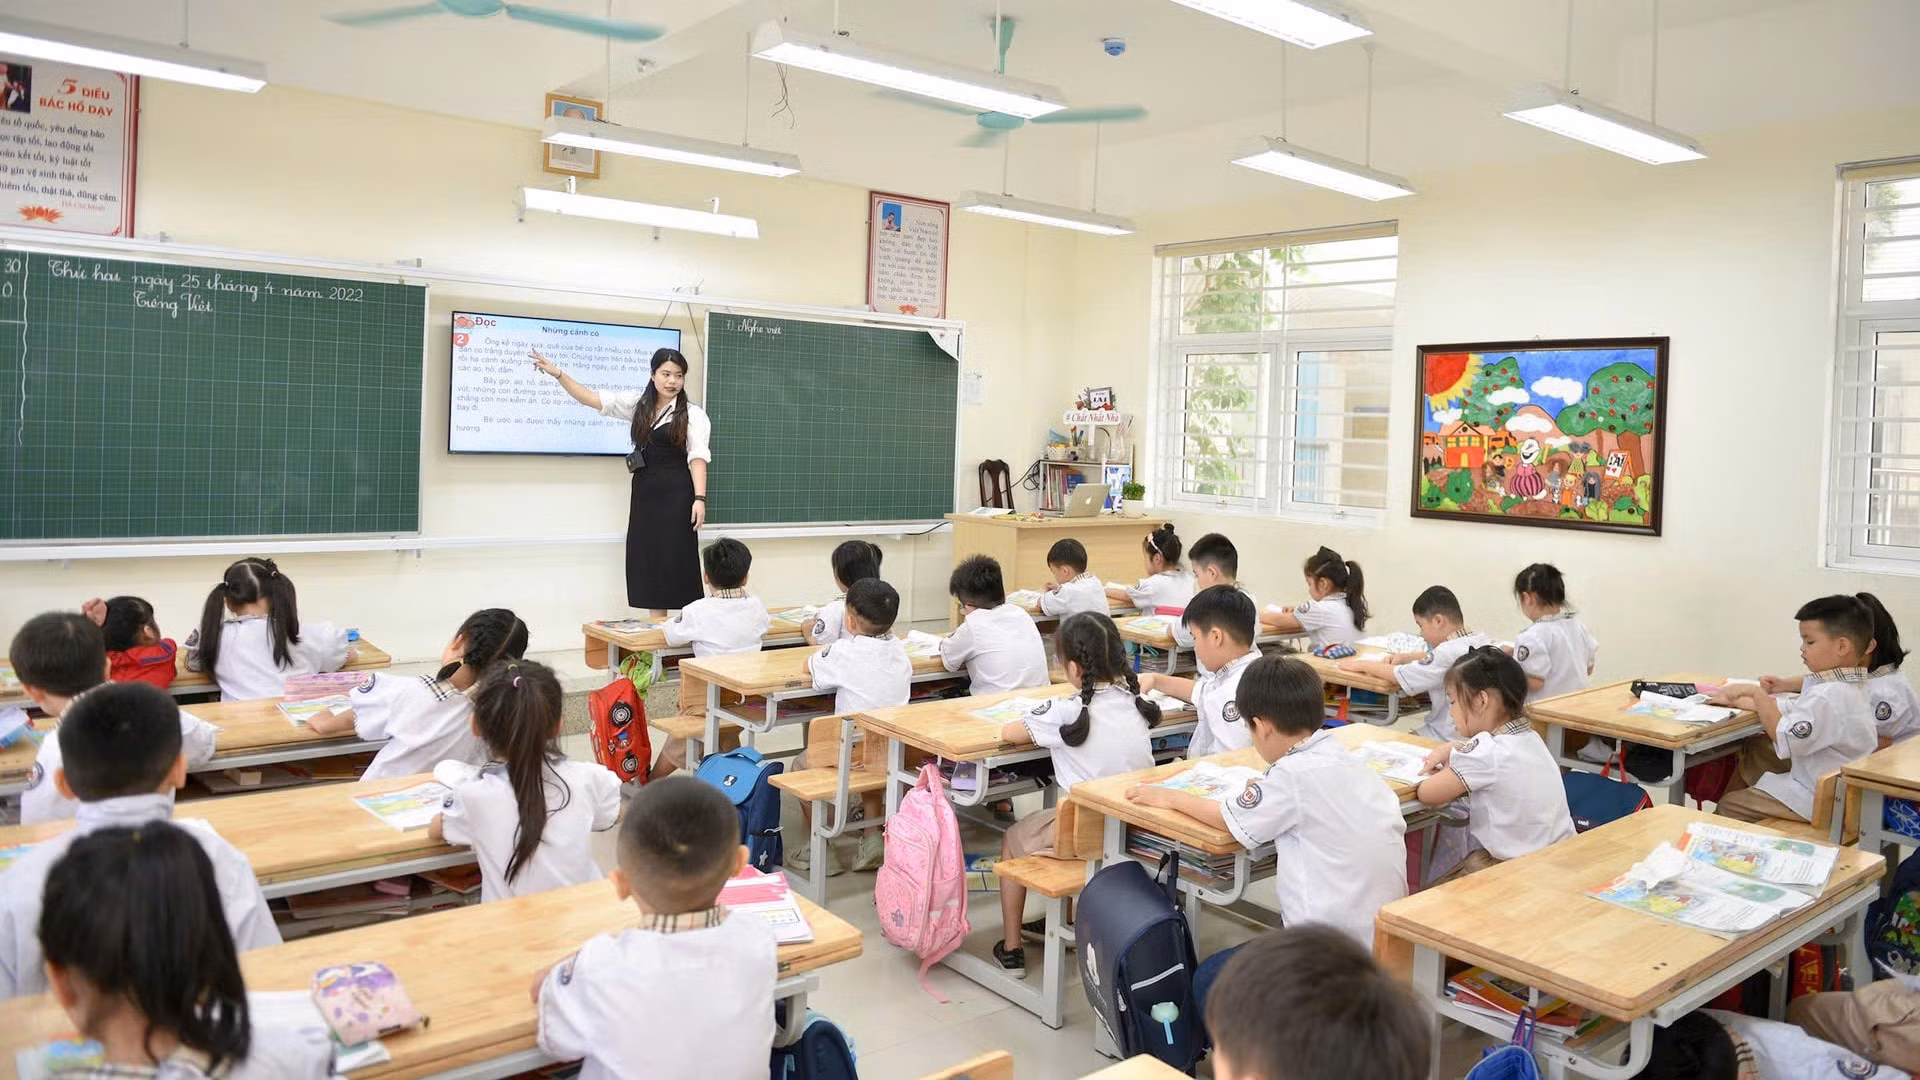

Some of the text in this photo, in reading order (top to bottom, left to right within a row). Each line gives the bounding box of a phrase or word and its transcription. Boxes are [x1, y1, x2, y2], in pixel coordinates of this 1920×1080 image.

[57, 78, 78, 95] 5
[40, 96, 113, 118] BÁC HỒ DẠY
[4, 258, 21, 274] 30
[132, 274, 175, 294] ngày
[180, 274, 200, 289] 25
[206, 273, 258, 302] tháng
[264, 281, 274, 295] 4
[329, 286, 364, 302] 2022
[475, 316, 497, 328] Đọc
[457, 334, 465, 344] 2
[542, 326, 568, 336] Những
